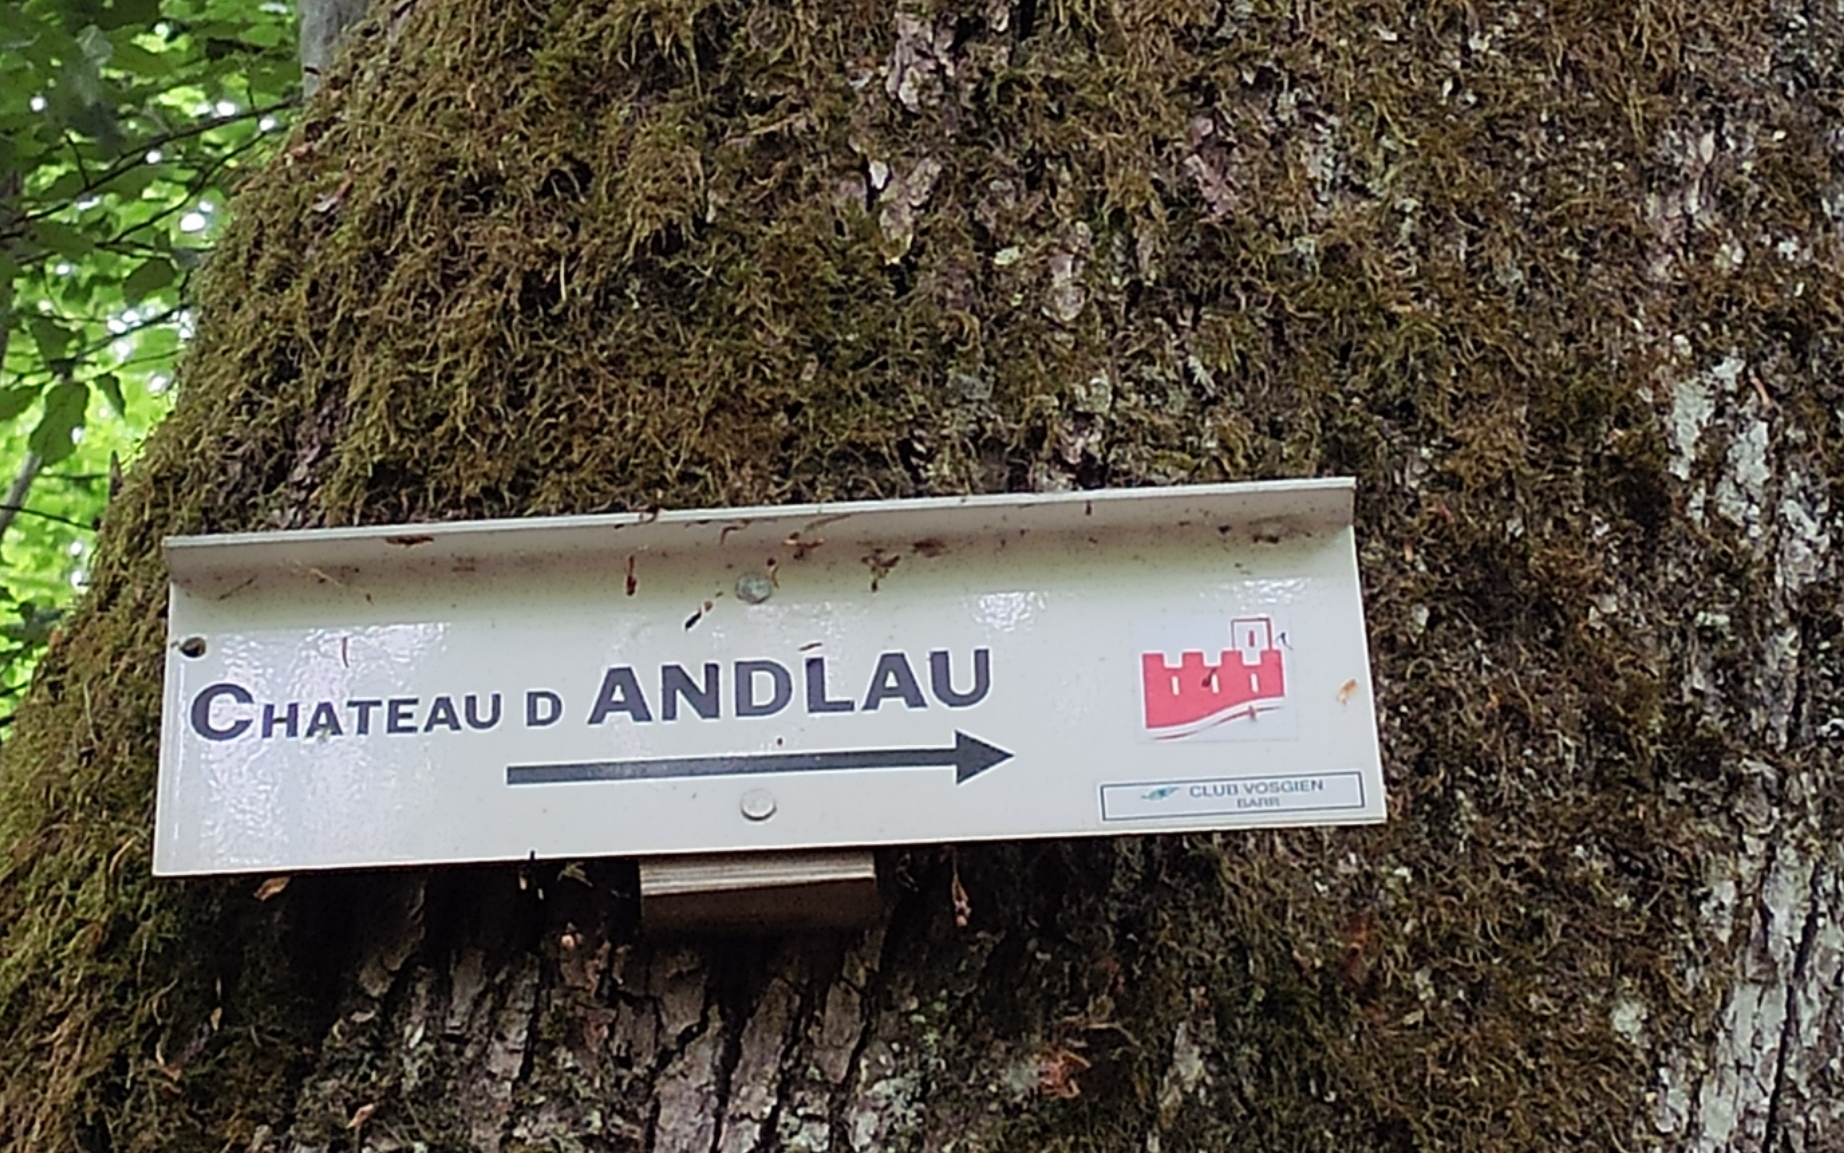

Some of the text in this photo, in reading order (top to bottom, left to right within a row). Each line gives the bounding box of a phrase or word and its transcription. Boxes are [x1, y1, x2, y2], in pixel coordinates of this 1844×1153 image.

[191, 649, 990, 741] CHATEAU D ANDLAU
[1189, 779, 1324, 798] CLUB VOSGIEN
[1236, 796, 1280, 809] BARR
